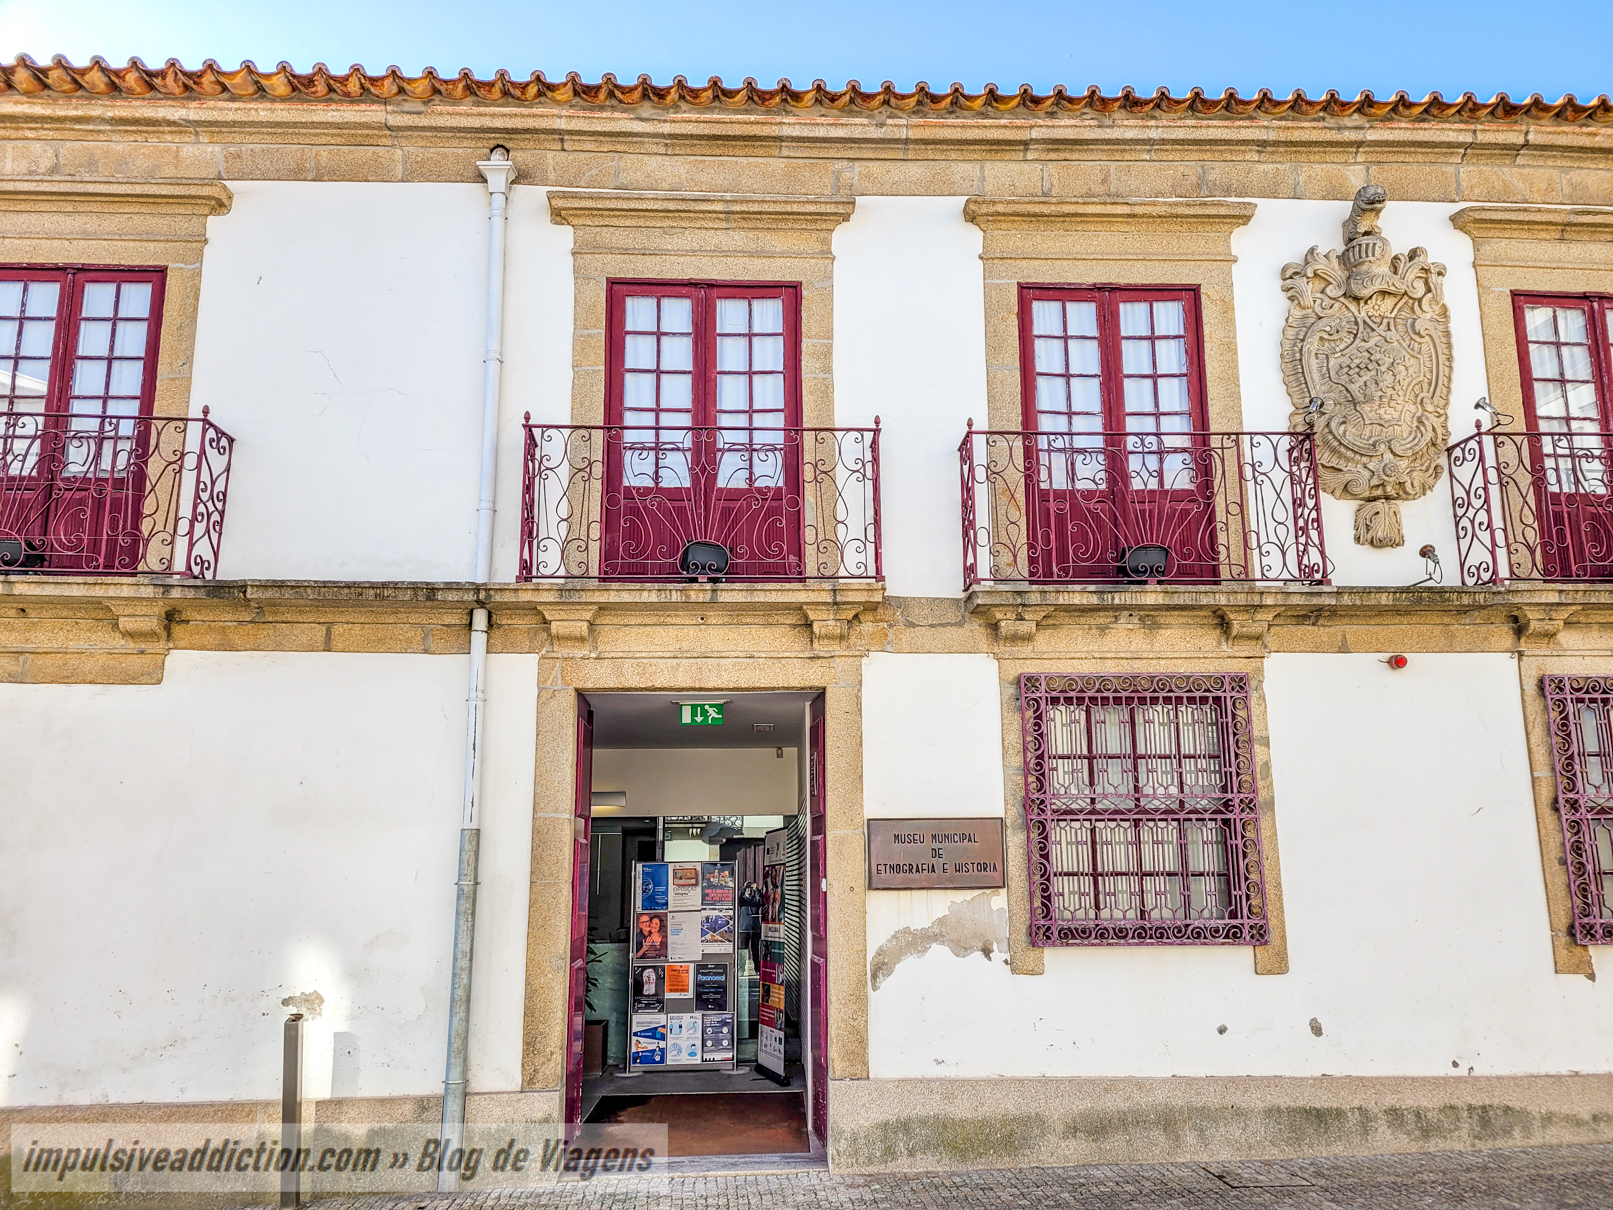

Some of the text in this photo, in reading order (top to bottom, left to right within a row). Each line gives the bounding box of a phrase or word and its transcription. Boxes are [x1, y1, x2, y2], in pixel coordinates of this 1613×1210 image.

[893, 833, 979, 844] MUSEU MUNICIPAL
[931, 848, 944, 859] DE
[876, 859, 998, 874] ETNOGRAFIA E HISTÓRIA
